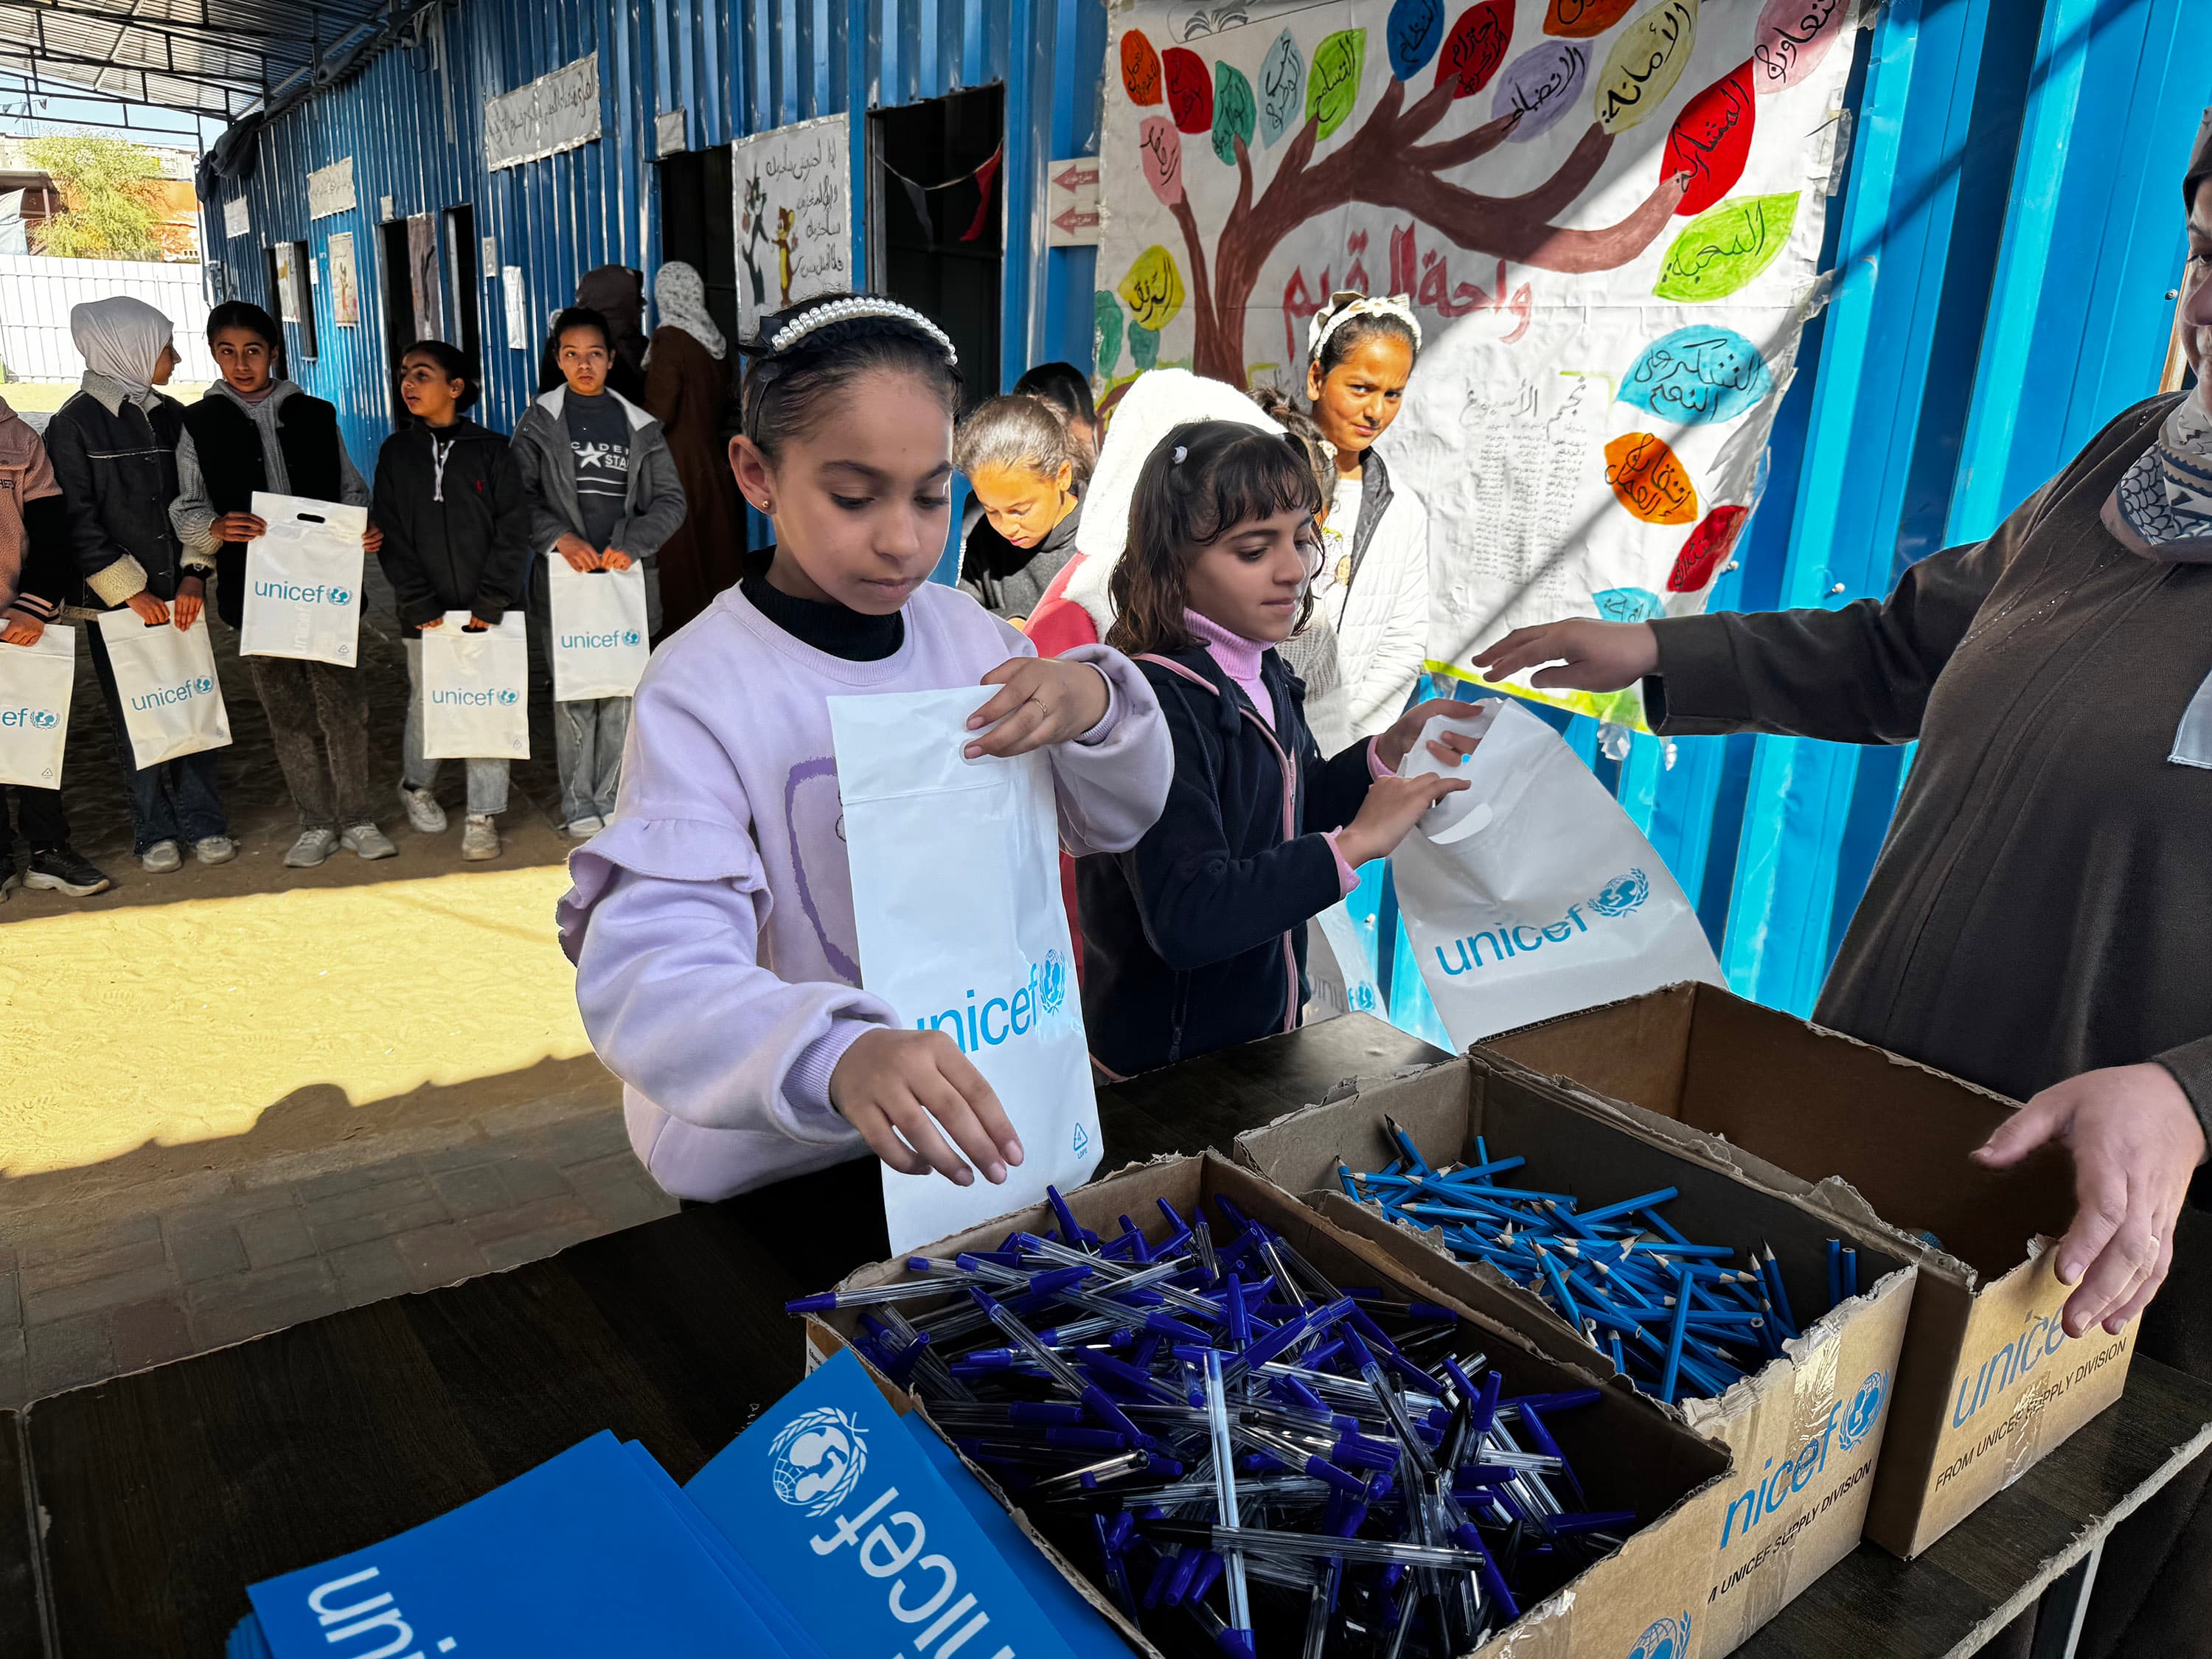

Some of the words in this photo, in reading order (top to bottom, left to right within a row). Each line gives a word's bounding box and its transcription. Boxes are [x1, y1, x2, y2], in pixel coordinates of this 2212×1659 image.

[605, 454, 630, 469] STA
[254, 580, 326, 605] unicef
[560, 630, 621, 649] unicef
[132, 680, 192, 712] unicef
[432, 687, 496, 707] unicef
[1435, 903, 1588, 975] unicef
[917, 962, 1037, 1054] nicef
[1952, 1306, 2065, 1429] unice
[1934, 1447, 1974, 1493] FROM
[2075, 1336, 2127, 1384] DIVISION
[1719, 1399, 1843, 1550] nicef
[1721, 1544, 1772, 1595] UNICEF
[1773, 1503, 1820, 1554] SUPPLY
[1820, 1458, 1872, 1514] DIVISION
